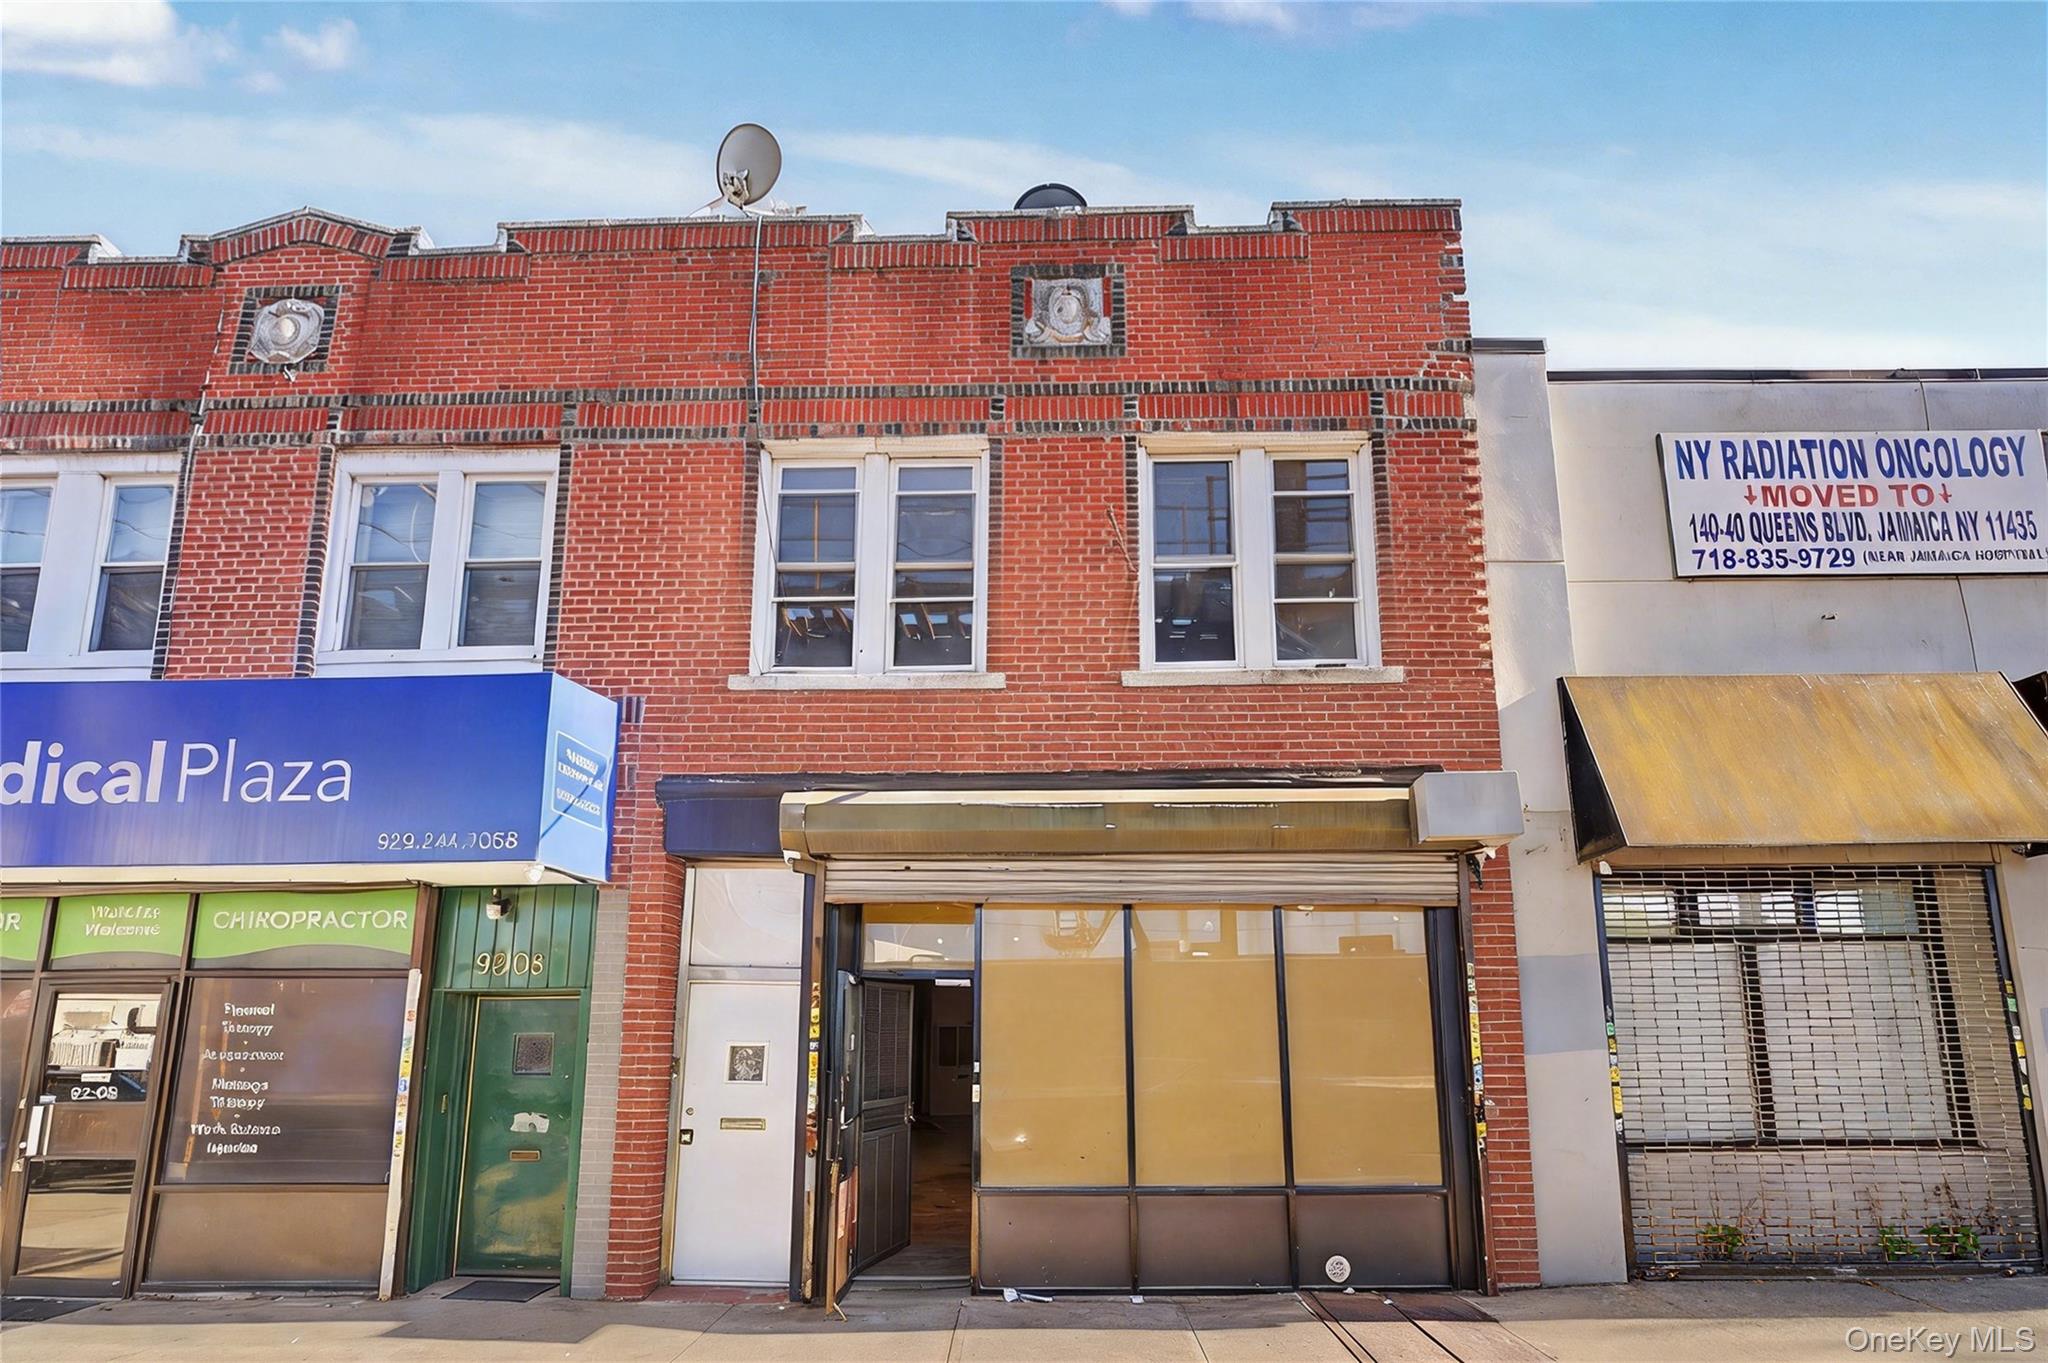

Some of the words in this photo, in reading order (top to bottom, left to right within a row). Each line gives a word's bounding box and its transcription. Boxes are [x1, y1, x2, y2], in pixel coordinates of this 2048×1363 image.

[1674, 439, 1711, 480] NY
[1720, 438, 1869, 480] RADIATION
[1874, 435, 2027, 479] ONCOLOGY
[1761, 484, 1879, 508] MOVED
[1888, 483, 1935, 508] TO
[1689, 513, 1745, 544] 140-40
[1749, 512, 1819, 545] QUEENS
[1824, 512, 1873, 543] BLVD.
[1877, 511, 1955, 542] JAMAICA
[1957, 511, 1980, 541] NY
[1985, 510, 2038, 541] 11435
[1691, 548, 1856, 570] 718-835-9729
[0, 740, 168, 805] dical
[177, 738, 353, 804] Plaza
[213, 910, 408, 931] CHIROPRACTOR
